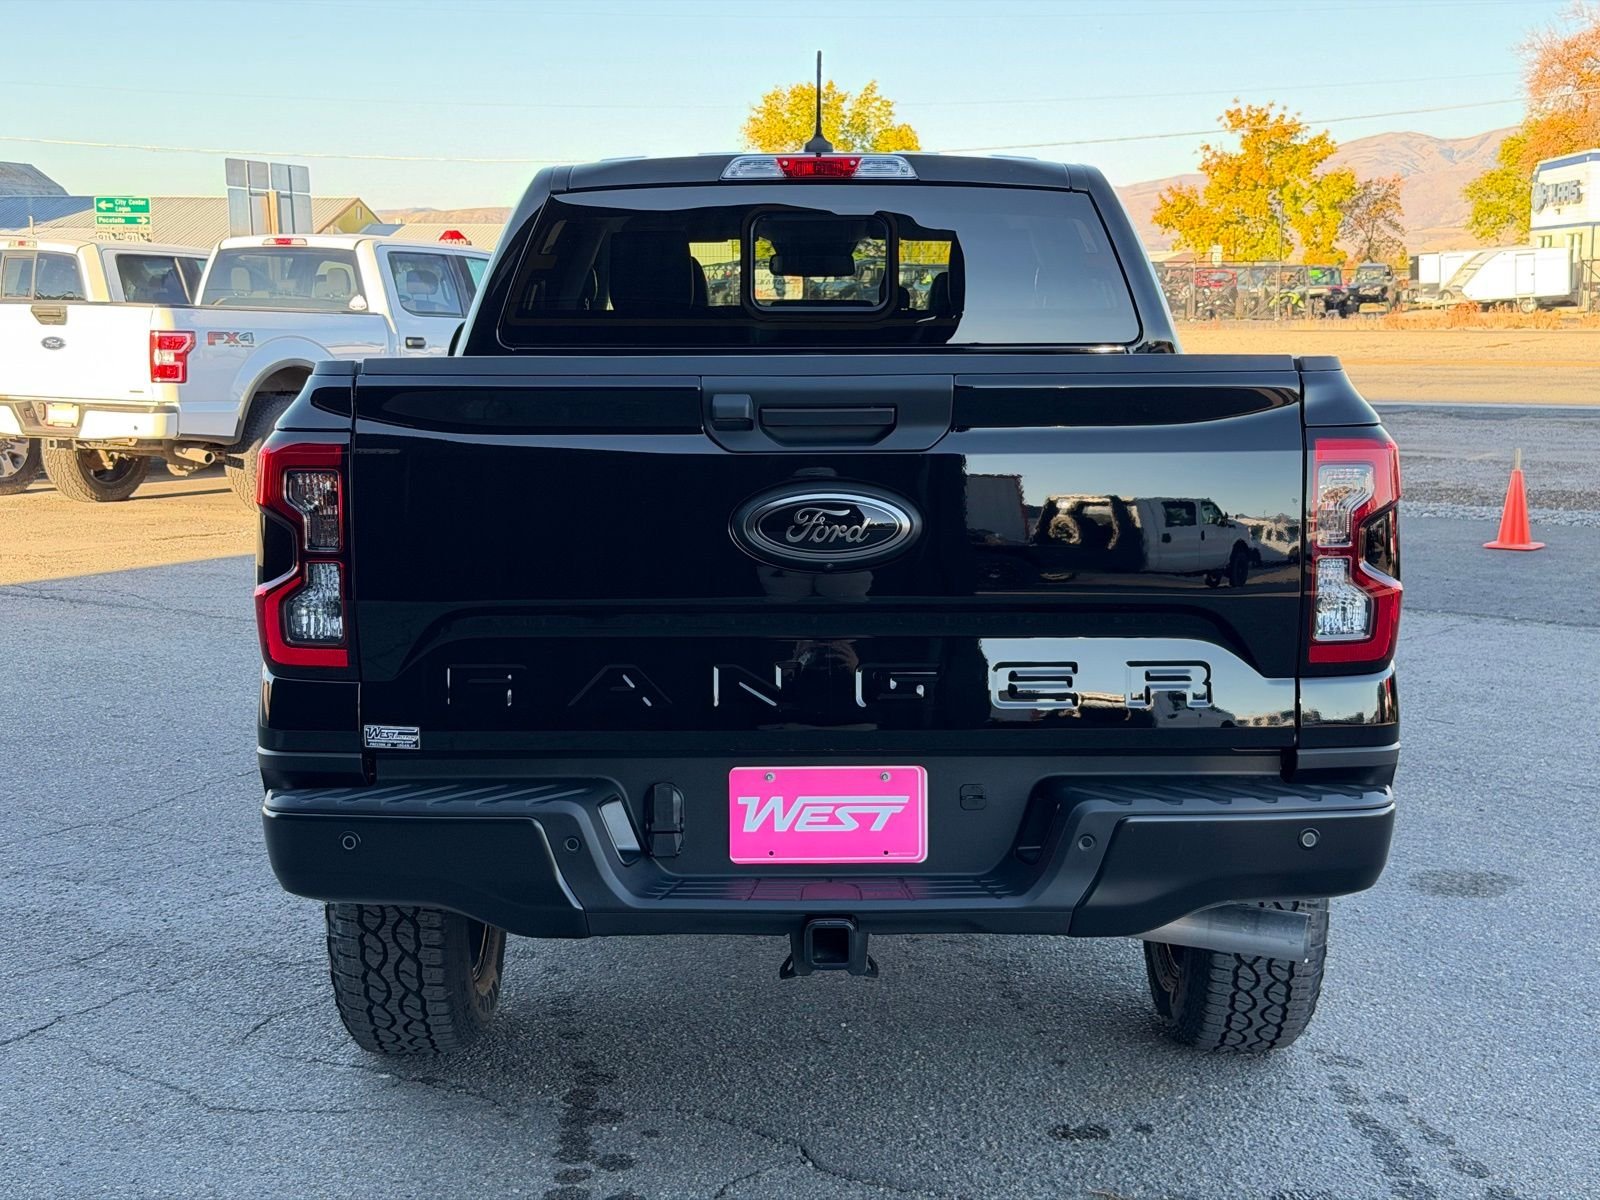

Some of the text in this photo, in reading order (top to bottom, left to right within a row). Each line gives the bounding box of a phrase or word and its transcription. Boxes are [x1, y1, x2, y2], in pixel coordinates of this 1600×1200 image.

[207, 331, 255, 346] FX4
[785, 507, 872, 543] Ford
[447, 660, 1214, 708] RANGER
[366, 726, 400, 740] WEST
[737, 795, 910, 832] WEST
